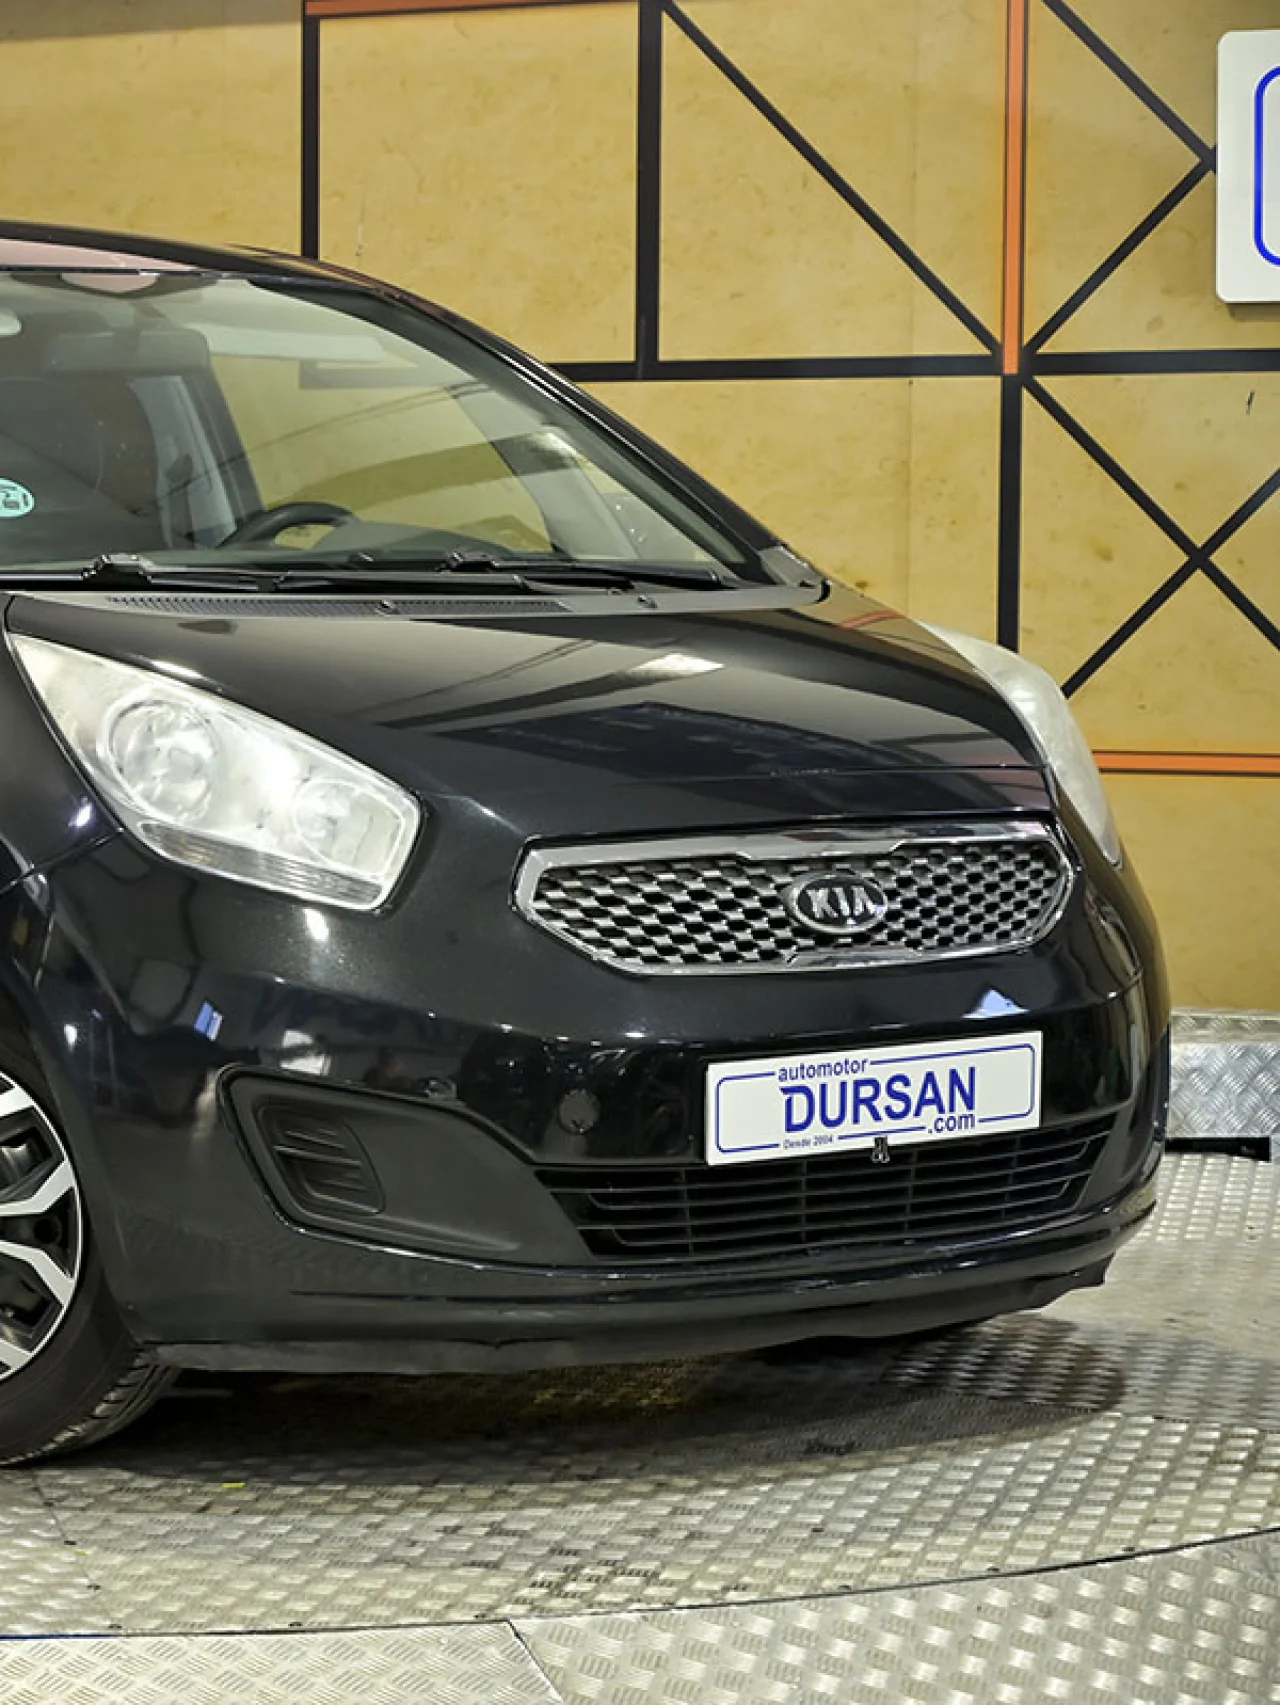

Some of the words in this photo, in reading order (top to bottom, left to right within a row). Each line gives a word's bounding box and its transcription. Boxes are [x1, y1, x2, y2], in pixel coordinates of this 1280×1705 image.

[805, 886, 877, 919] KIA
[778, 1057, 869, 1083] automotor
[779, 1066, 976, 1133] DURSAN
[927, 1112, 976, 1135] .com
